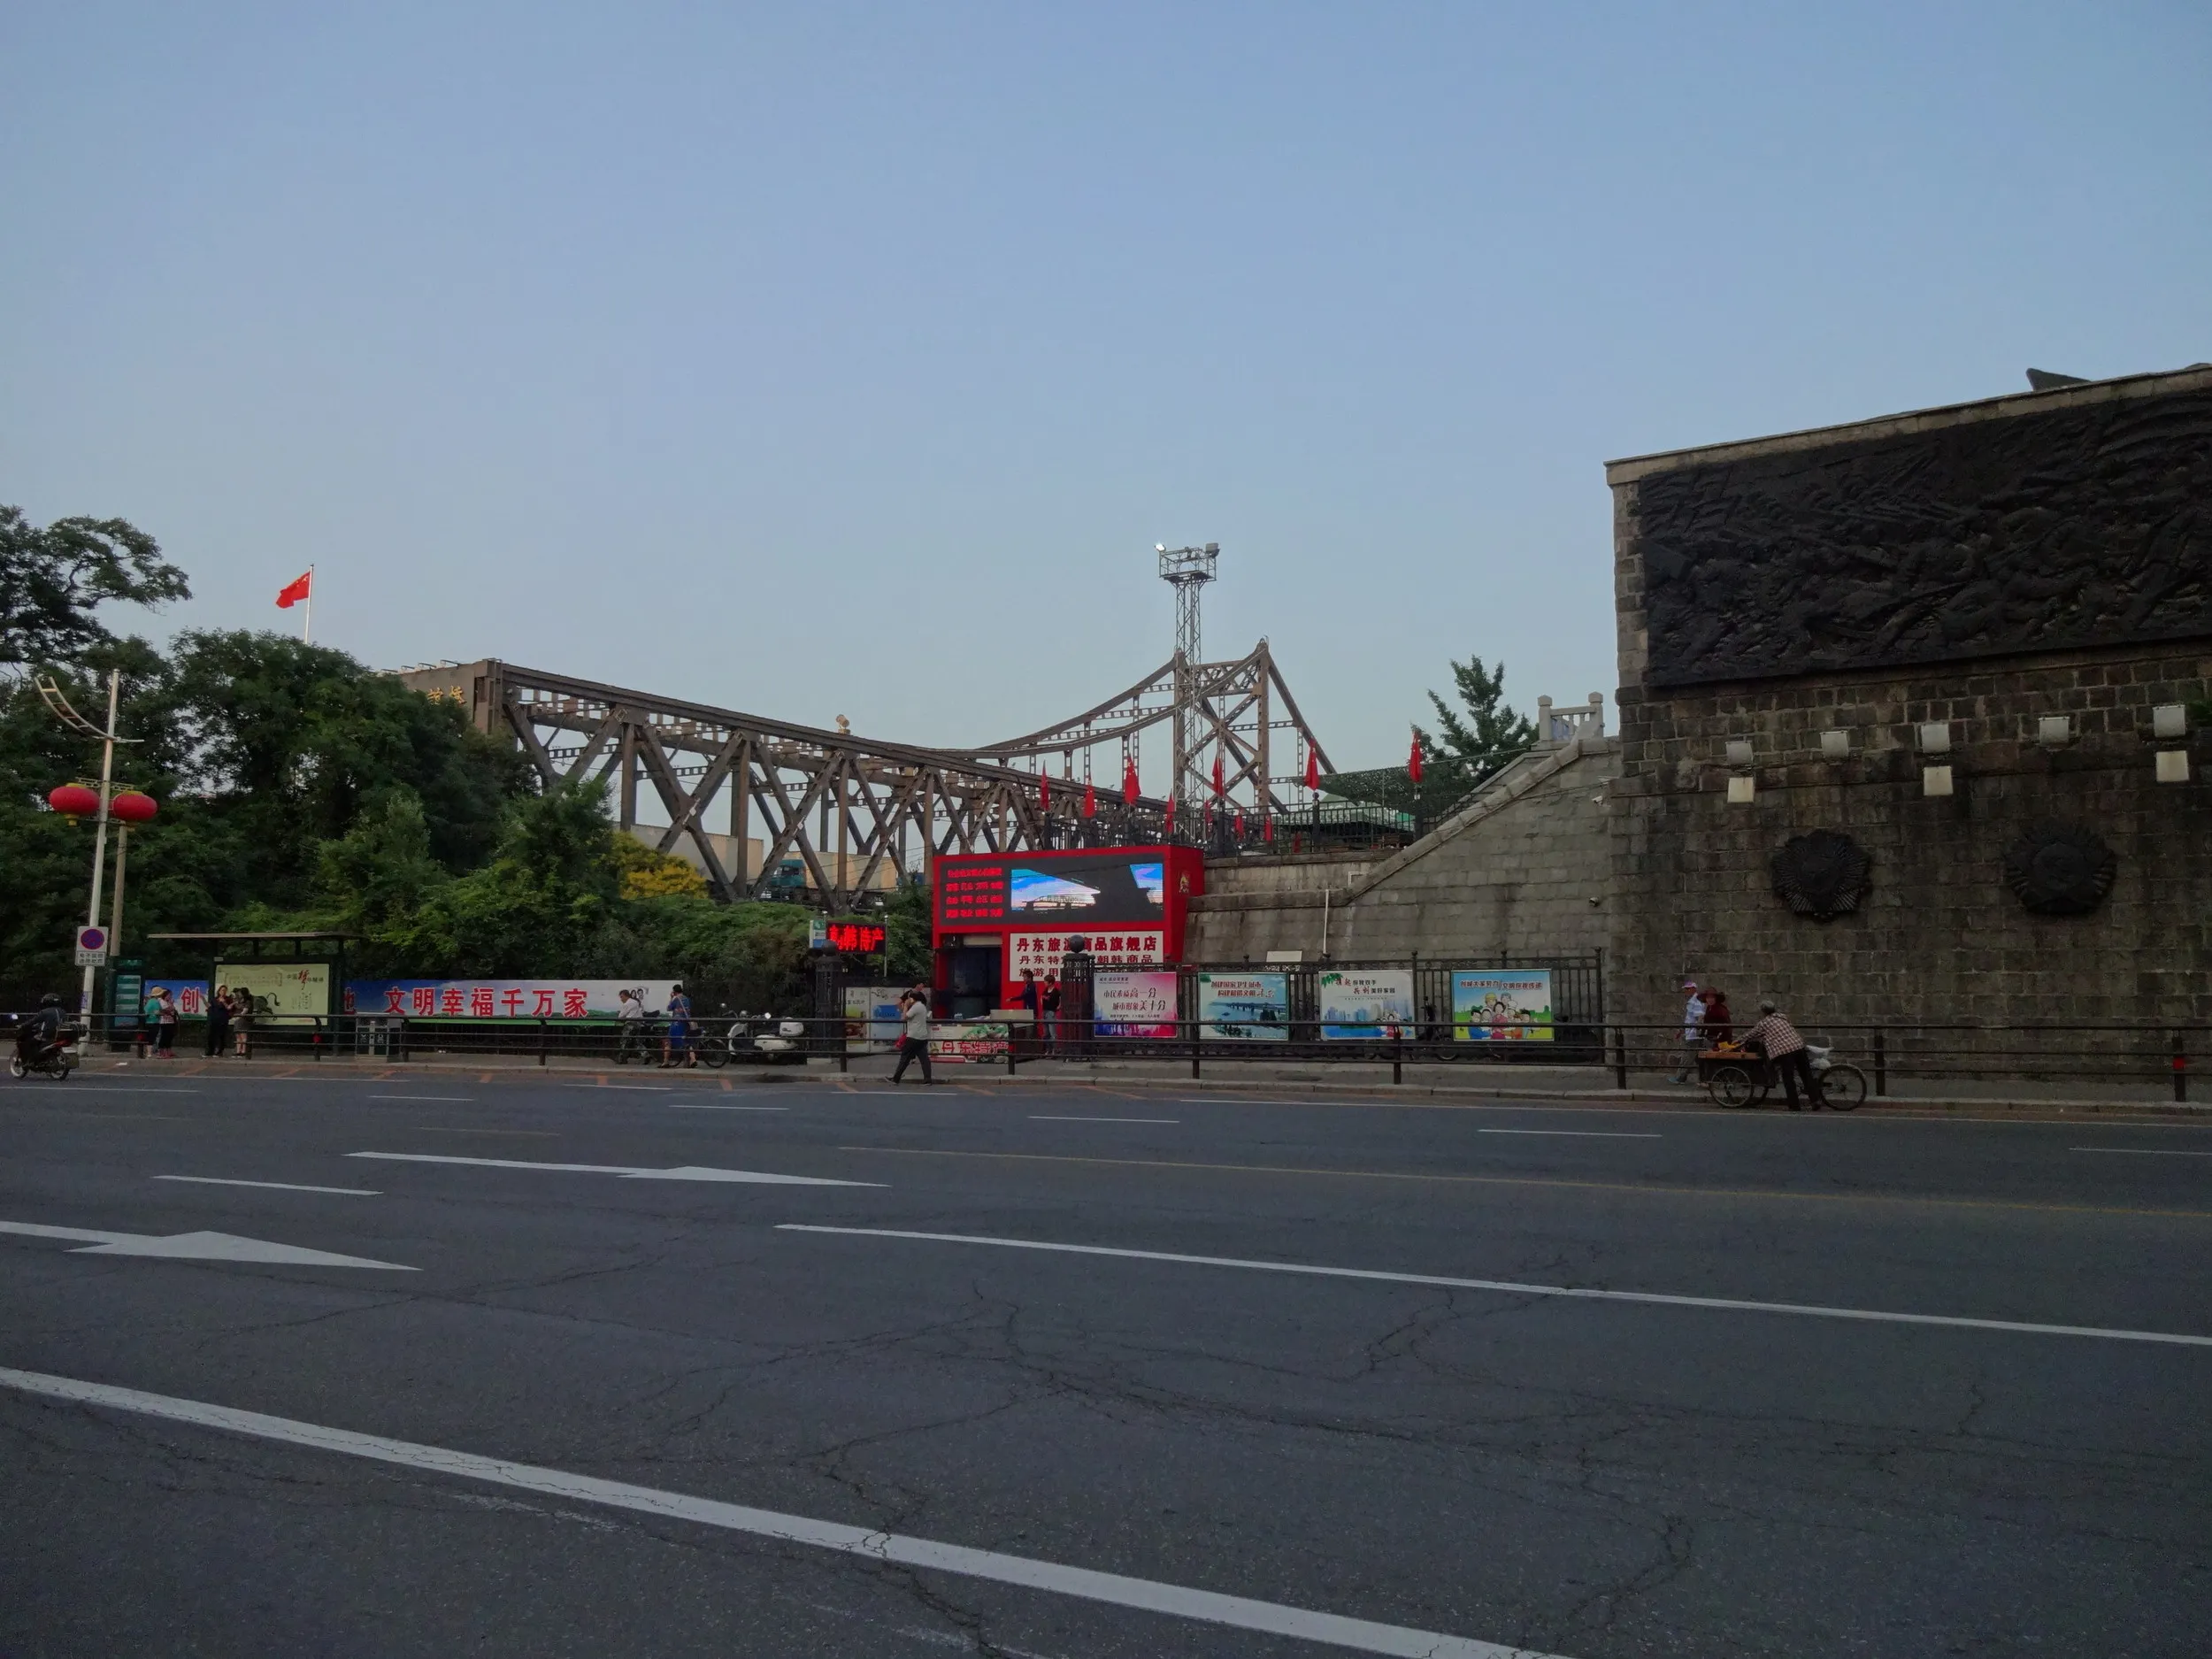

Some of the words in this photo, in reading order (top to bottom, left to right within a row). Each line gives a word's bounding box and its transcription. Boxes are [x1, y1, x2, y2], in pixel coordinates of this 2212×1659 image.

[1019, 955, 1065, 964] 丹东特
[384, 987, 589, 1018] 文明幸福千万家
